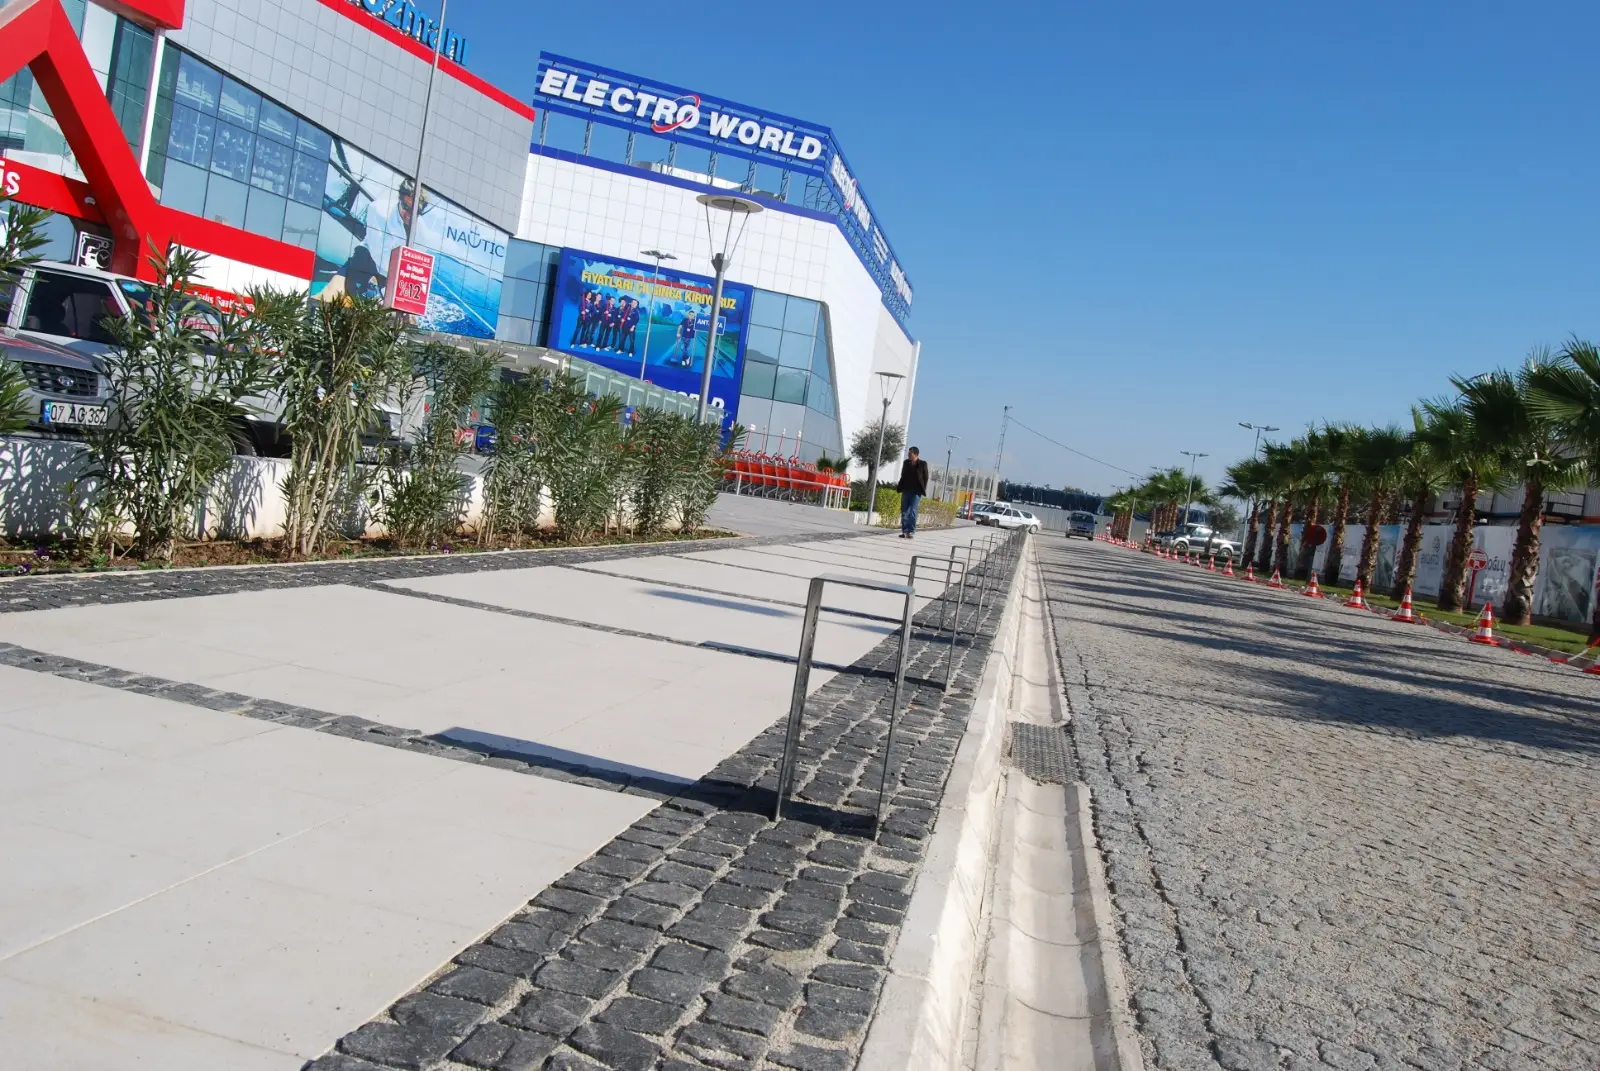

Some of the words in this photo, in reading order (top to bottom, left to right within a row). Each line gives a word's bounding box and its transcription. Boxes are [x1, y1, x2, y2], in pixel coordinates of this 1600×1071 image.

[539, 68, 700, 130] ELECTRO
[709, 111, 822, 161] WORLD
[446, 225, 505, 258] NAUTIC
[51, 404, 65, 421] 07
[68, 405, 87, 423] AG
